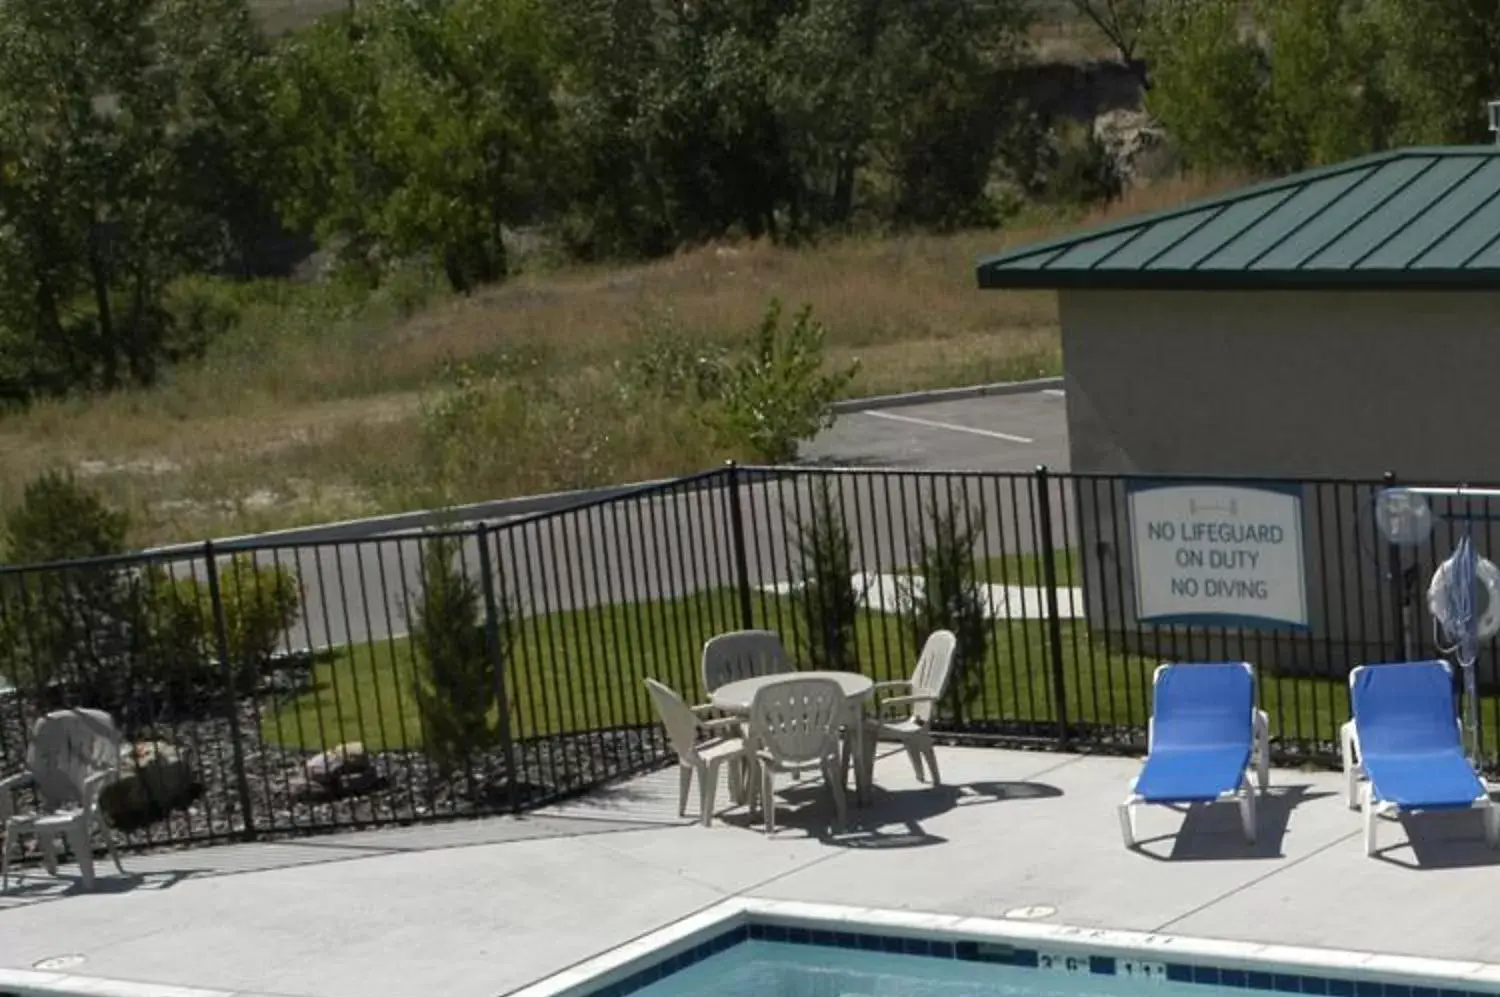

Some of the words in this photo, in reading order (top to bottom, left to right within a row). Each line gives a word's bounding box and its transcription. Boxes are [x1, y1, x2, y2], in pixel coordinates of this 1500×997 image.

[1148, 522, 1175, 541] NO
[1181, 523, 1283, 544] LIFEGUARD
[1175, 548, 1203, 568] ON
[1209, 550, 1260, 569] DUTY
[1171, 578, 1198, 597] NO
[1205, 580, 1268, 600] DIVING
